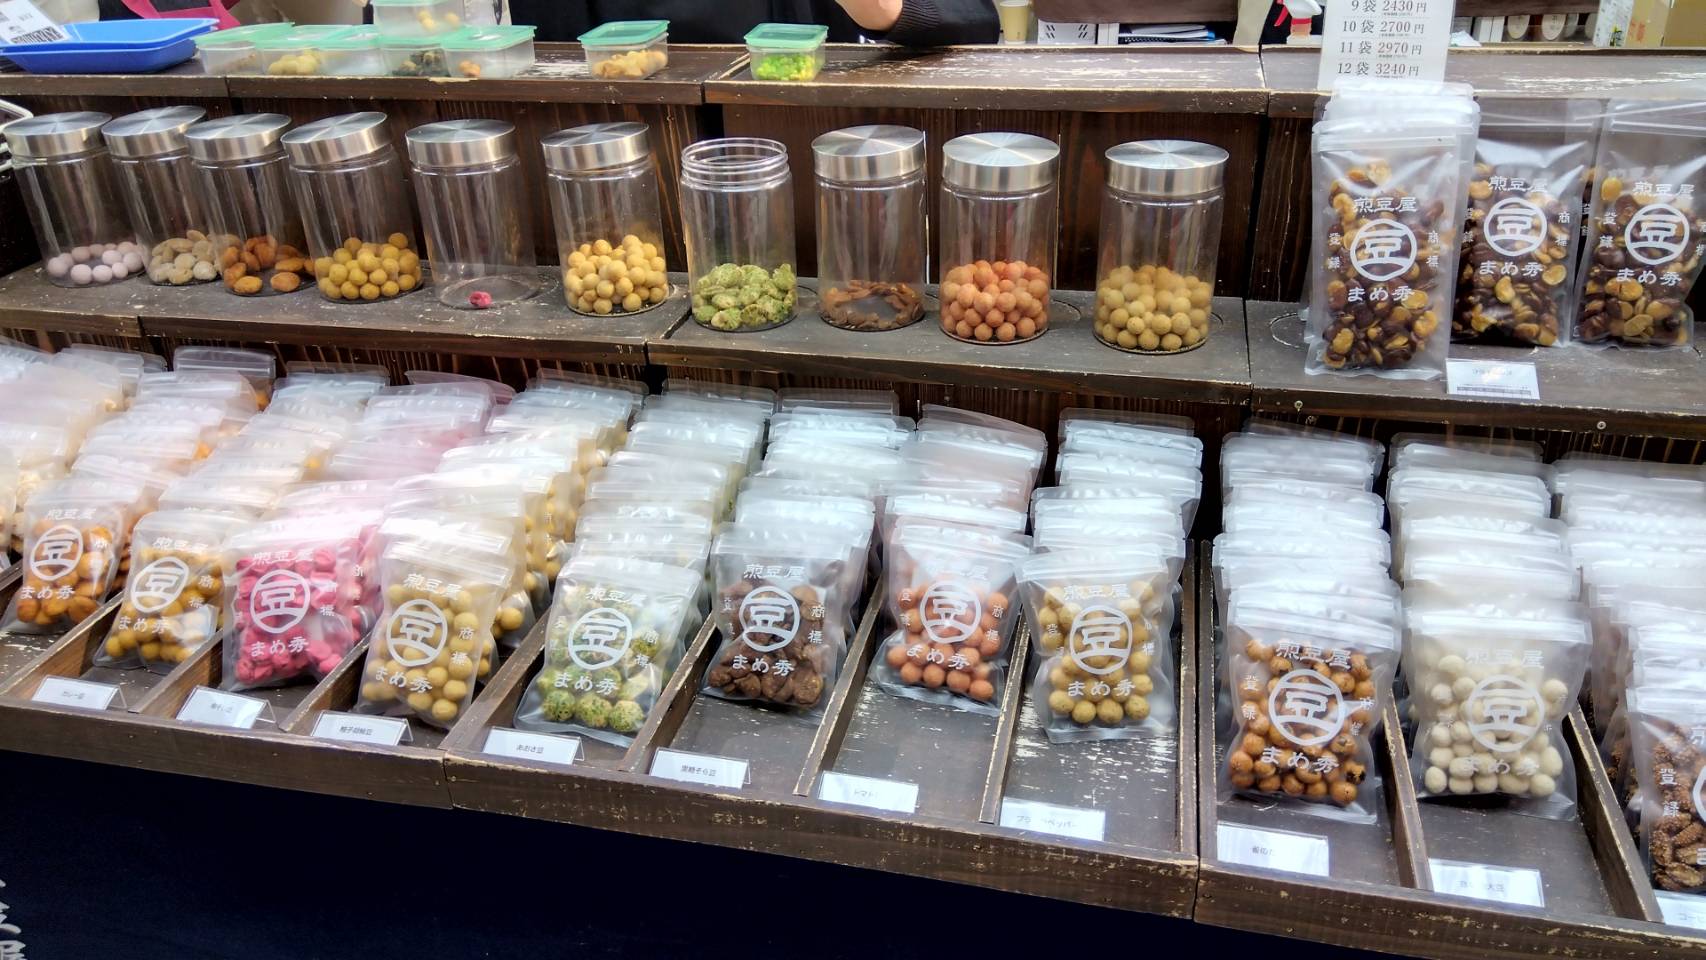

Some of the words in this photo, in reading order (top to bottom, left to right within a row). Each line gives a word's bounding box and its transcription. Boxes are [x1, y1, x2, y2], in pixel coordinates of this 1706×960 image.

[1479, 260, 1543, 276] まめ秀
[1616, 267, 1682, 286] まめ秀
[1347, 285, 1414, 302] まめ秀
[20, 585, 76, 600] まめ秀
[250, 636, 310, 657] まめ秀
[906, 644, 971, 670] まめ秀
[732, 654, 795, 677] まめ秀
[375, 667, 433, 693] まめ秀
[553, 671, 619, 695] まめ秀
[1068, 679, 1136, 697] まめ秀
[1260, 746, 1340, 773] まめ秀
